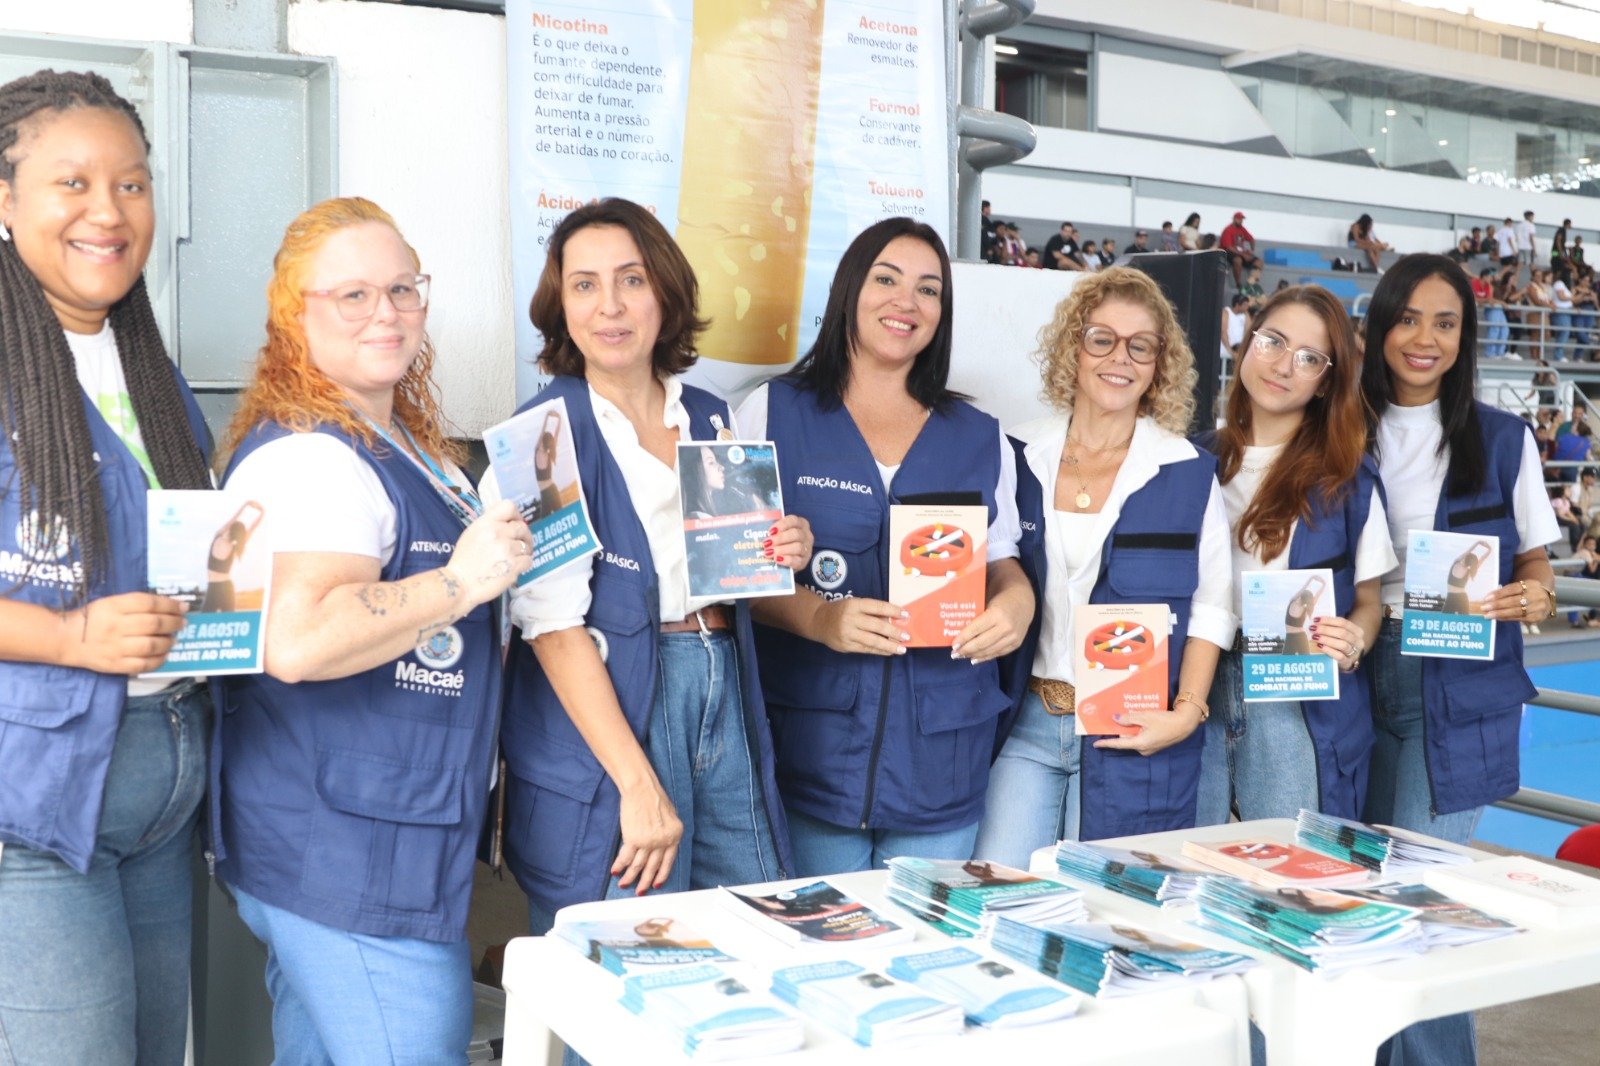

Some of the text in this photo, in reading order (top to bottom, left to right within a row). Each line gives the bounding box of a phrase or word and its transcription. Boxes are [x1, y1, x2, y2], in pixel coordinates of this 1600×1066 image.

[532, 12, 609, 35] Nicotina
[859, 15, 918, 36] Acetona
[532, 32, 629, 56] É o que deixa o
[847, 32, 918, 53] Removedor de
[533, 51, 586, 68] fumante
[870, 53, 918, 69] esmaltes.
[533, 71, 664, 95] com dificuldade para
[534, 87, 635, 109] deixar de fumar.
[869, 97, 920, 116] Formol
[534, 105, 650, 127] Aumenta a pressão
[859, 115, 922, 133] Conservante
[535, 123, 654, 144] arterial e o número
[862, 132, 921, 149] de cadáver.
[535, 139, 674, 165] de batidas no coração.
[868, 180, 924, 199] Tolueno
[881, 201, 925, 216] Solvente
[797, 476, 873, 496] ATENÇÃO BÁSICA
[544, 512, 579, 541] AGOSTO
[606, 552, 640, 572] BÁSICA
[197, 621, 250, 639] AGOSTO
[1410, 618, 1483, 633] 29 DE AGOSTO
[1406, 637, 1485, 650] COMBATE AO FUMO
[219, 648, 251, 659] FUMO
[395, 660, 464, 689] Macaé
[1251, 662, 1325, 675] 29 DE AGOSTO
[395, 681, 462, 697] PREFEITURA
[1249, 682, 1329, 692] COMBATE AO FUMO
